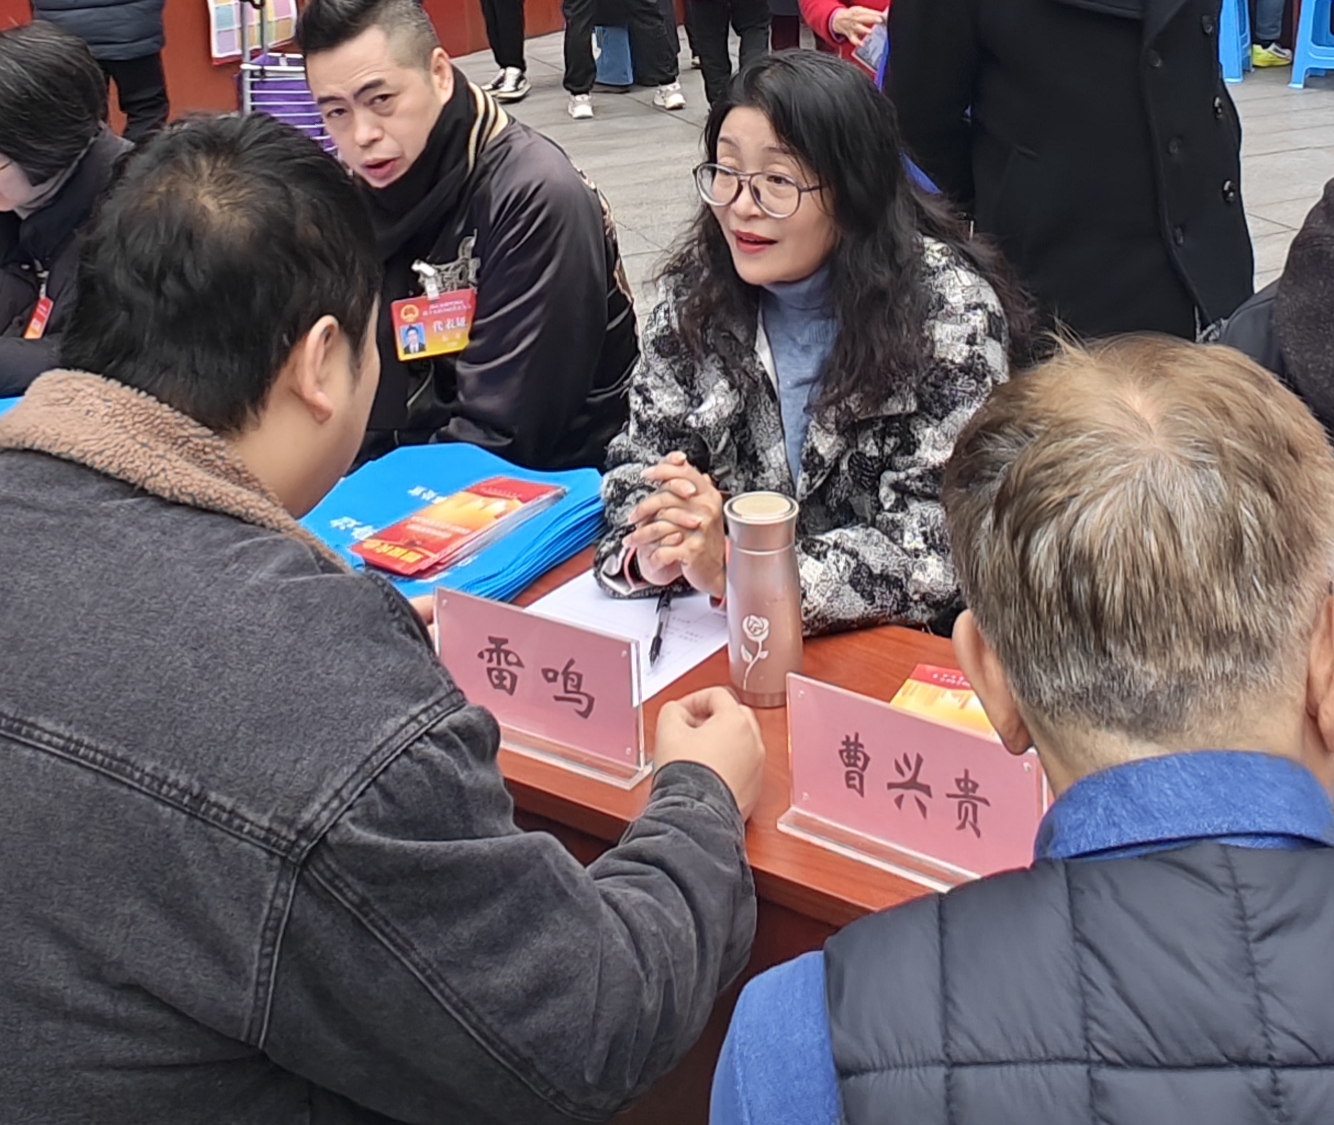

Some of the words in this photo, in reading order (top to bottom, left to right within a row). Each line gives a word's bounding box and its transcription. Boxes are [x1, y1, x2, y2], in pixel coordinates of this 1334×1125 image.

[476, 634, 596, 720] 雷鸣
[837, 732, 991, 839] 曹兴贵
